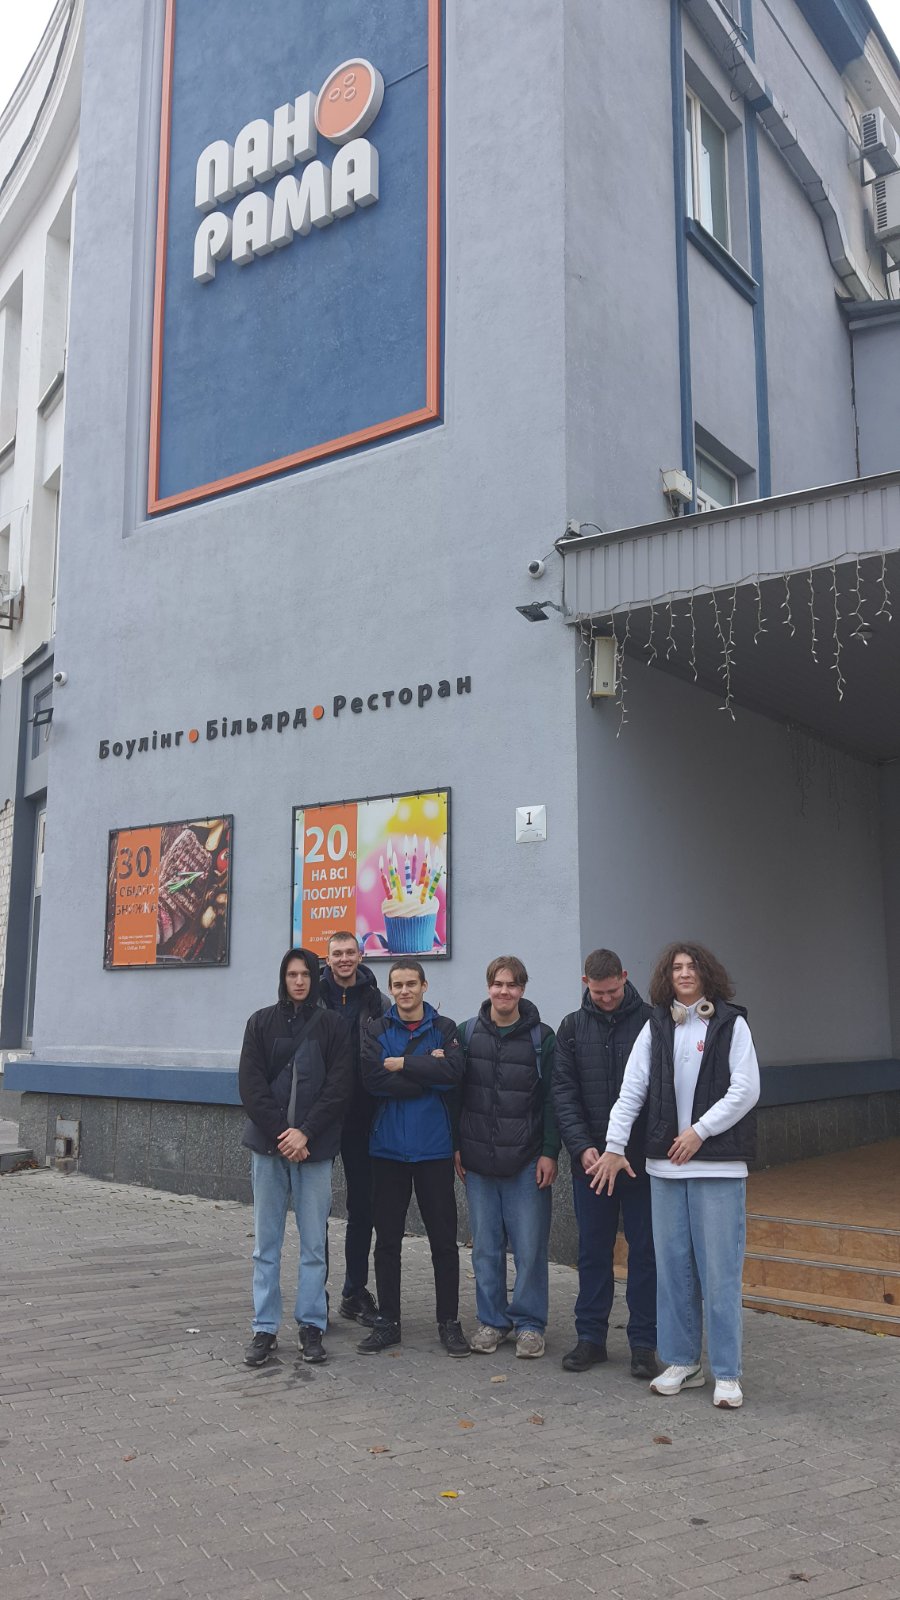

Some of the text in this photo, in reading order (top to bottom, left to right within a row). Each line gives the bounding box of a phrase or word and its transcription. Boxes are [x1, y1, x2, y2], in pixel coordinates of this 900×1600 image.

[193, 137, 379, 284] РАМА
[99, 675, 472, 760] Боулінг Більярд Ресторан
[526, 811, 533, 825] 1
[311, 867, 348, 882] НА ВСІ
[303, 885, 356, 901] ПОСЛУГИ
[310, 905, 348, 920] КЛУБУ
